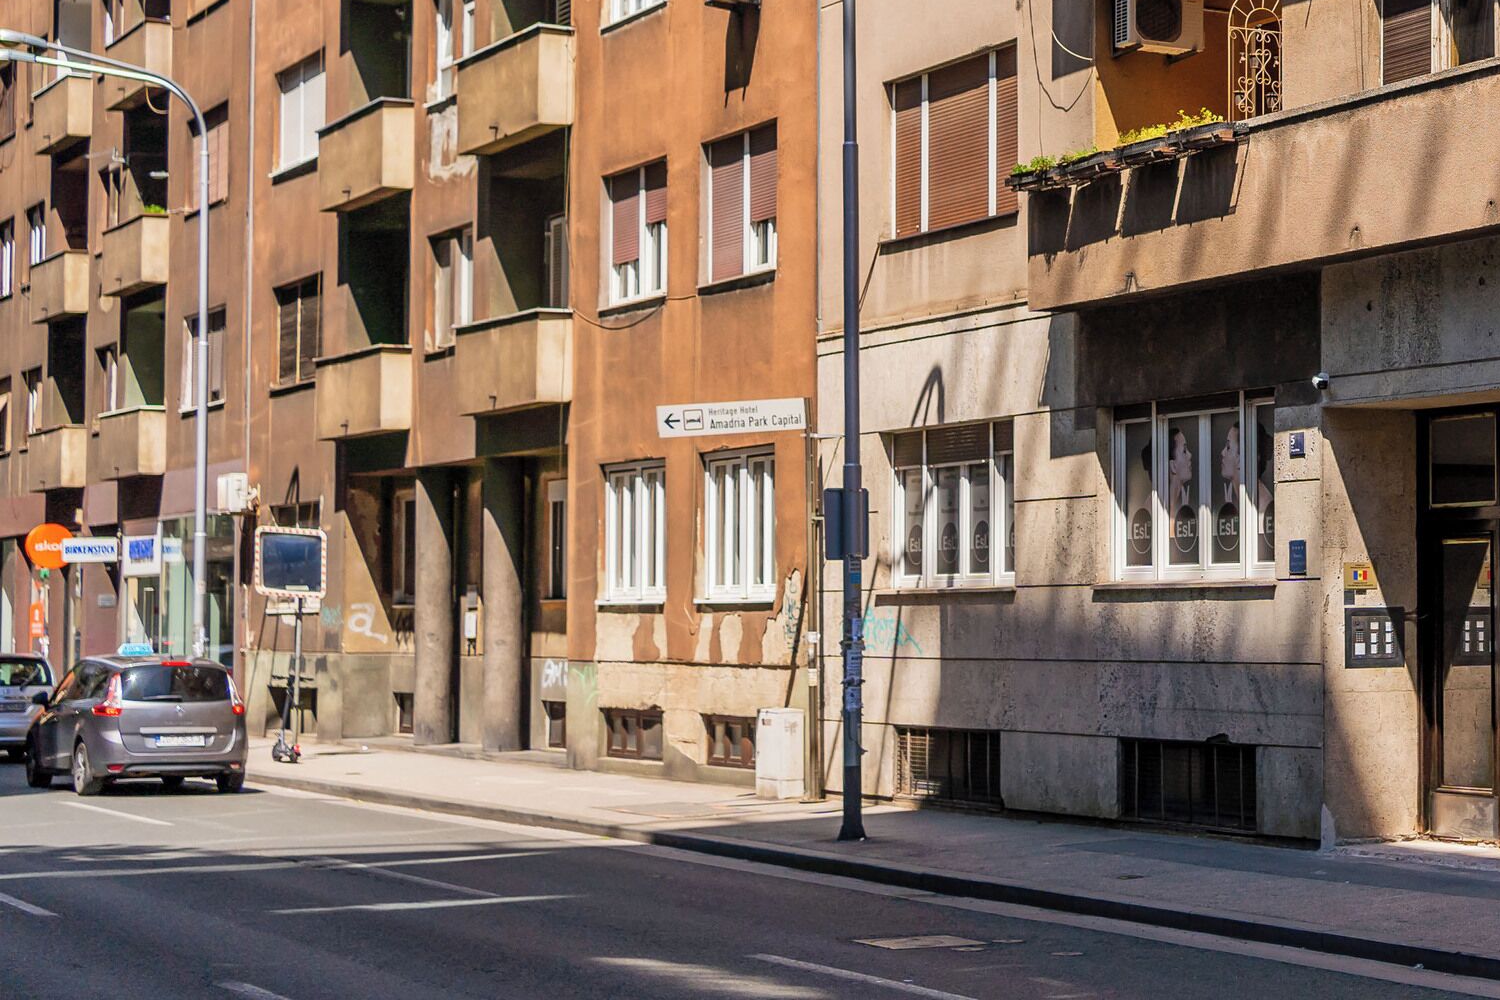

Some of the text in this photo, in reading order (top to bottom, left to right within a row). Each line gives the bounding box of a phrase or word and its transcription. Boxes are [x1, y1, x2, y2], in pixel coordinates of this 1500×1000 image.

[708, 405, 758, 417] Heritage Hotel
[710, 414, 802, 430] Amadria Park Capital
[64, 545, 116, 555] BIRKENSTOCK
